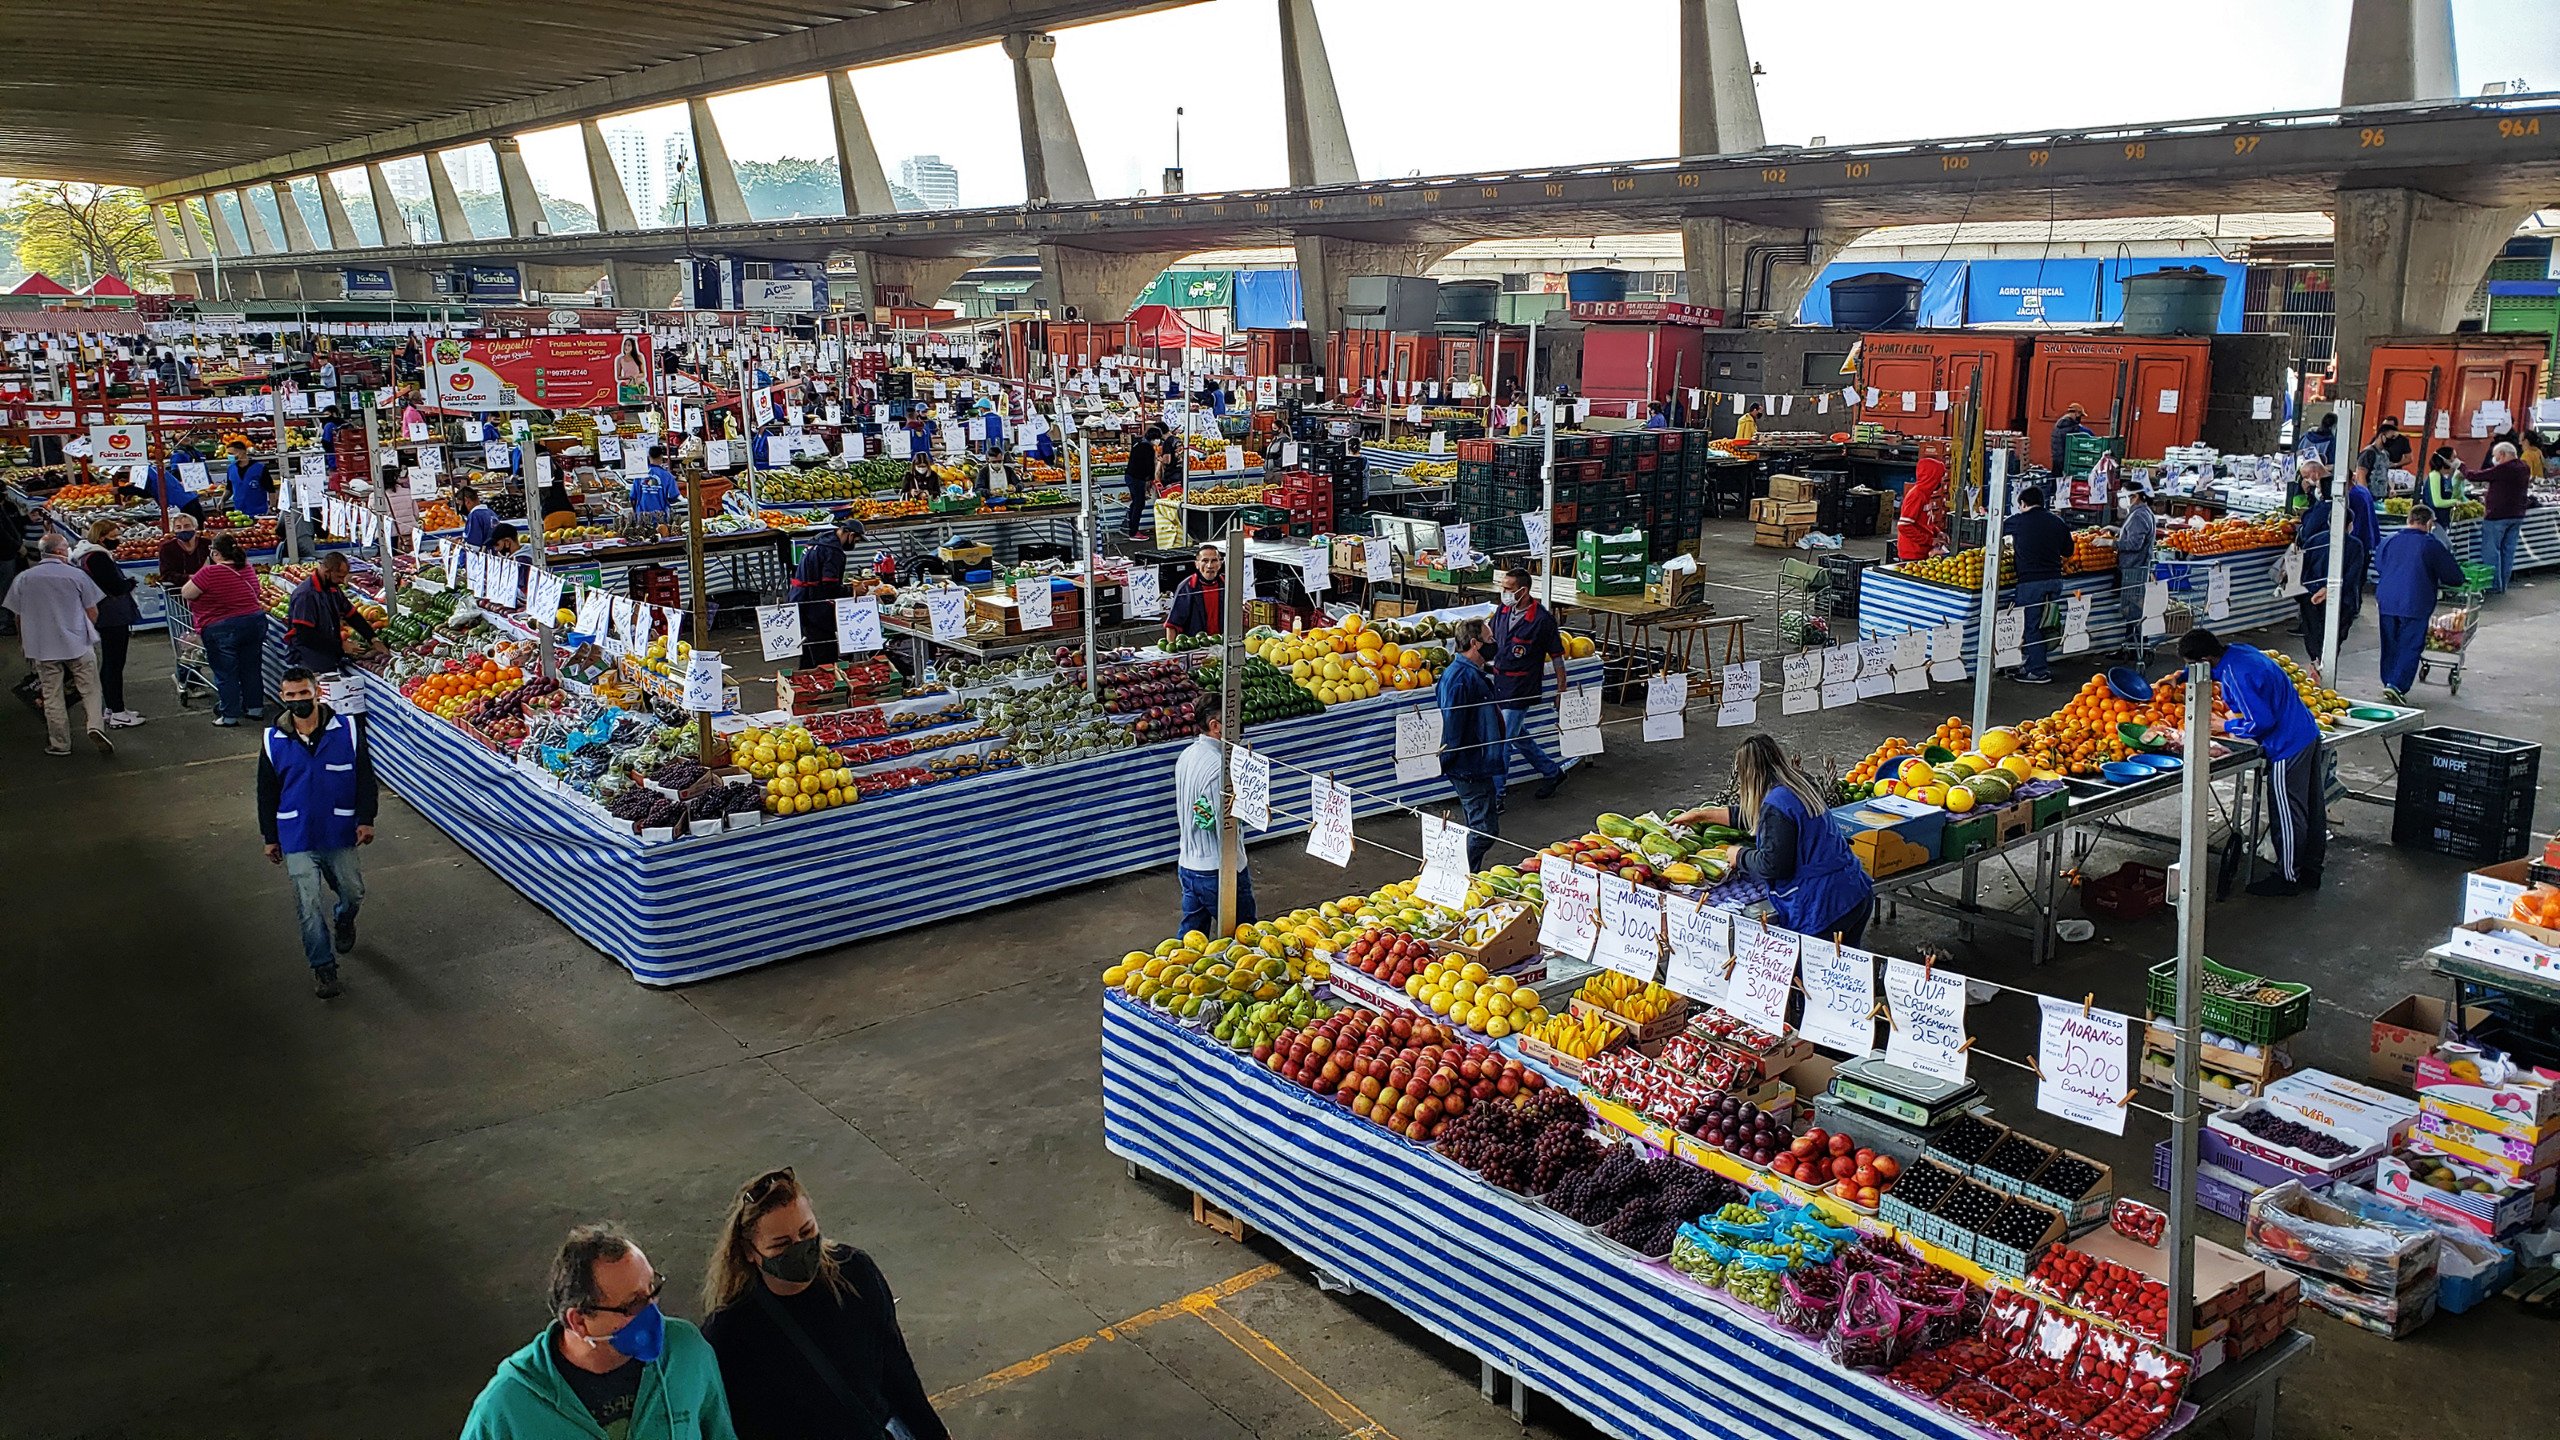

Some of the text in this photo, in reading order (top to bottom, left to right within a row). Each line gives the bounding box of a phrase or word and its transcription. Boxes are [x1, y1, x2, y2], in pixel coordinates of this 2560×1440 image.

[2498, 118, 2541, 138] 96A
[2360, 128, 2385, 148] 96
[2124, 144, 2146, 160] 98
[2233, 136, 2260, 155] 97
[1940, 156, 1970, 172] 100
[2029, 150, 2050, 167] 99
[1761, 168, 1787, 183] 102
[1844, 162, 1870, 178] 101
[1611, 178, 1635, 192] 104
[1677, 174, 1701, 188] 103
[1423, 192, 1440, 203] 107
[1481, 188, 1499, 198] 106
[1545, 184, 1564, 197] 105
[1255, 203, 1269, 213] 110
[1309, 199, 1324, 210] 109
[1367, 196, 1384, 207] 108
[1170, 207, 1183, 218] 112
[1213, 205, 1224, 216] 111
[1999, 287, 2065, 296] AGRO COMERCIAL
[2016, 306, 2045, 316] JACARÉ
[551, 348, 606, 357] Legumes Ovos
[466, 393, 486, 401] Casa
[690, 412, 695, 421] 6
[416, 425, 421, 434] 1
[471, 425, 477, 434] 2
[2433, 756, 2467, 772] DON PEPE
[1617, 890, 1660, 911] MORANGO
[1688, 912, 1712, 935] UVA
[1699, 911, 1727, 924] CEAGESP
[1679, 927, 1721, 952] ROSADA
[1767, 930, 1797, 943] CEAGESP
[1839, 950, 1869, 963] CEAGESP
[1831, 956, 1851, 972] UVA
[1929, 973, 1962, 987] CEAGESP
[1914, 979, 1945, 1000] UVA
[1903, 994, 1955, 1018] CRIMSON
[2086, 1013, 2123, 1028] CEAGESP
[2060, 1018, 2124, 1046] MORANGO
[2057, 1039, 2120, 1083] 12.00
